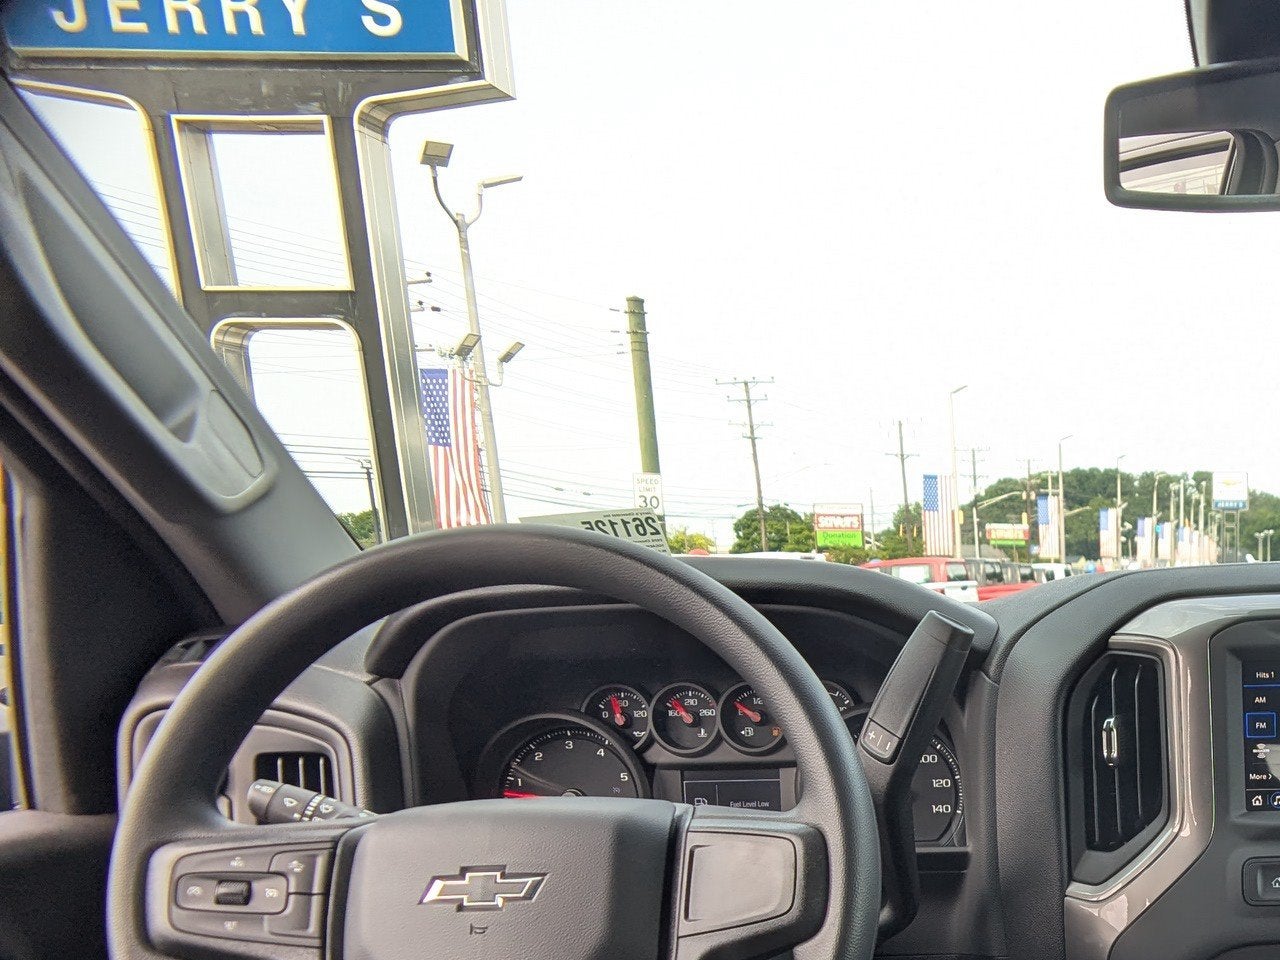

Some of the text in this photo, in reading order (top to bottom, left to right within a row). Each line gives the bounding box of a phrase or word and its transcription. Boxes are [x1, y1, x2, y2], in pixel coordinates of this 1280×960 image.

[51, 0, 403, 37] JERRYS
[638, 494, 660, 510] 30
[1254, 696, 1267, 704] AM
[633, 710, 648, 718] 120
[1255, 721, 1267, 729] FM
[565, 740, 574, 749] 3
[534, 752, 543, 761] 2
[596, 748, 605, 757] 4
[920, 754, 938, 763] 00
[620, 772, 629, 781] 5
[932, 778, 951, 788] 120
[742, 800, 757, 808] Level
[757, 800, 770, 808] Low
[931, 804, 951, 813] 140
